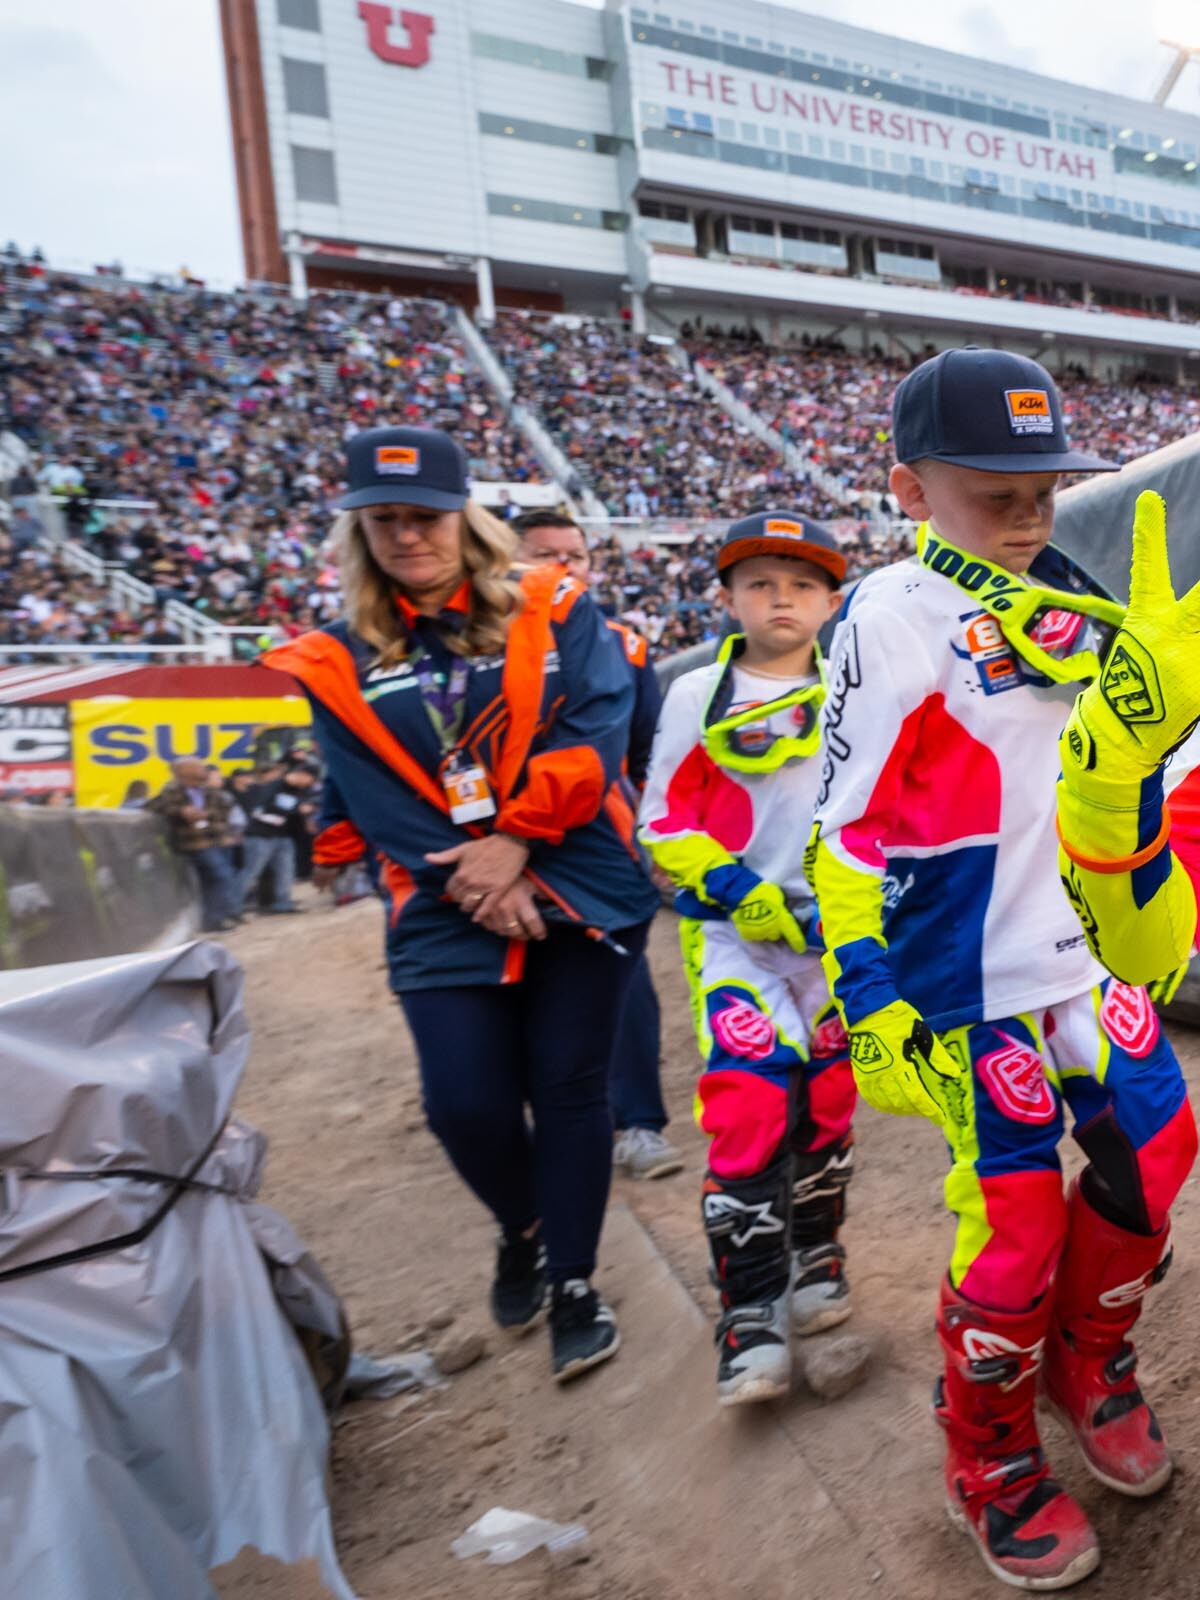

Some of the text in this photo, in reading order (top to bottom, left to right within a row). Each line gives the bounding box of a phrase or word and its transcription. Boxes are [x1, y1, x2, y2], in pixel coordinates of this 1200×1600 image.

[356, 1, 433, 68] U
[659, 61, 1096, 180] THE UNIVERSITY OF UTAH
[1018, 397, 1044, 410] KTM
[921, 538, 1027, 613] 100%
[972, 619, 1003, 648] 8
[90, 723, 256, 766] SUZ
